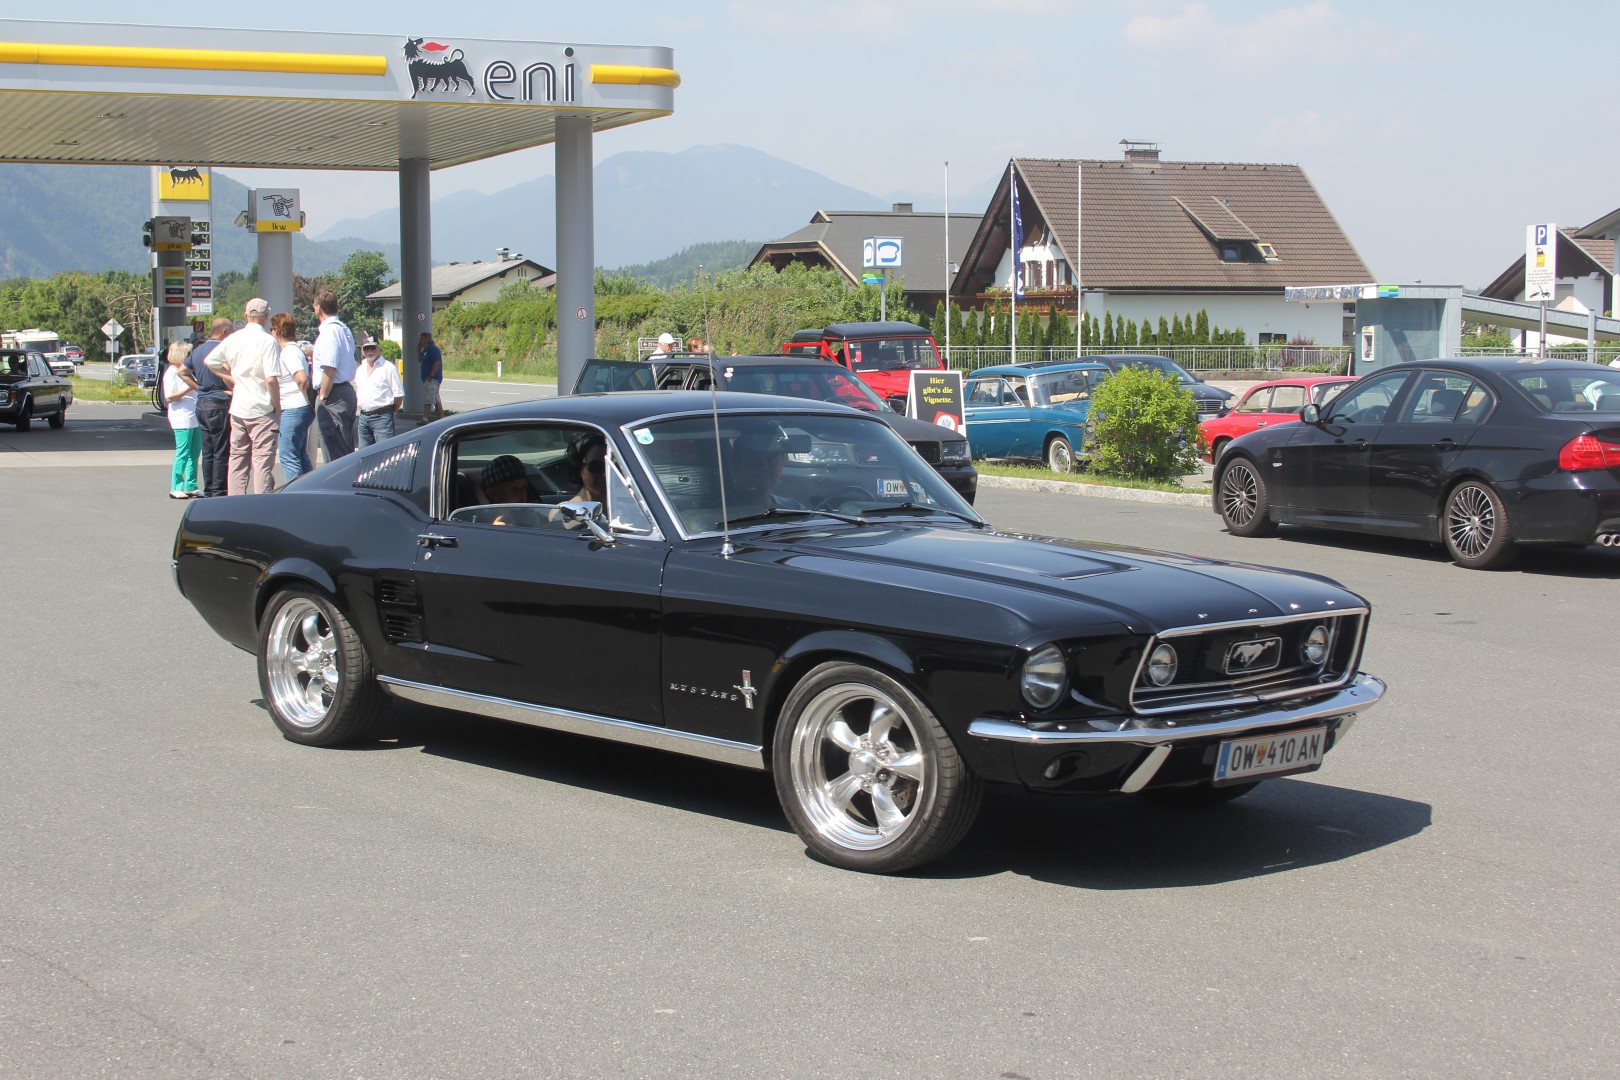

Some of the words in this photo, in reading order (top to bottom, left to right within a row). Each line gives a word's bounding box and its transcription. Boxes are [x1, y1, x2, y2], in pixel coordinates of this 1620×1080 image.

[482, 46, 575, 102] eni
[272, 222, 287, 231] lkw
[1537, 226, 1546, 244] P
[167, 242, 182, 250] pkw
[922, 386, 941, 395] gibt's
[942, 386, 954, 394] die
[923, 396, 954, 405] Vignette.
[886, 482, 899, 492] OW
[1230, 743, 1258, 772] OW
[1266, 738, 1296, 766] 410
[1297, 733, 1321, 762] AN
